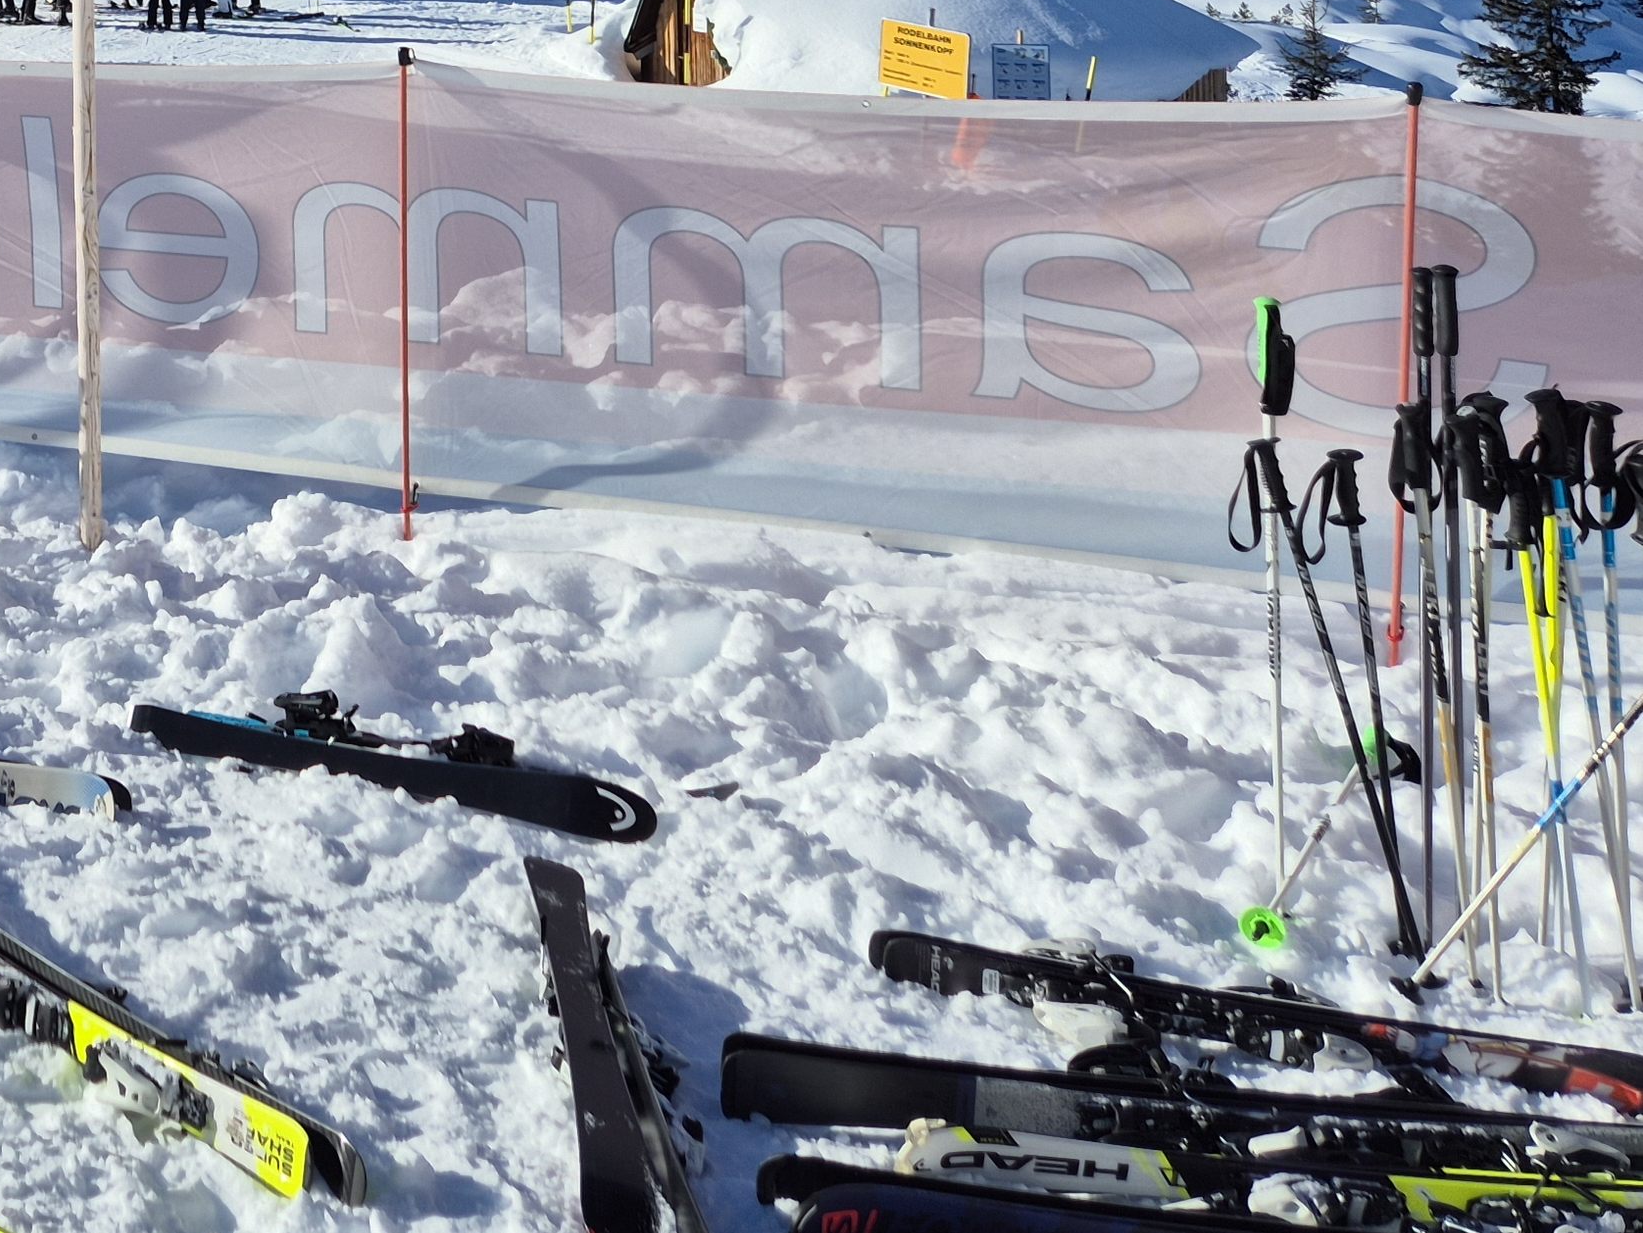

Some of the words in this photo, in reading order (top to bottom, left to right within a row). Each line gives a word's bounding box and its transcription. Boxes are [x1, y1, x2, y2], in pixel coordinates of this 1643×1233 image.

[893, 36, 955, 56] SONNENKOPF
[897, 26, 952, 44] RODELBAHN
[1423, 567, 1439, 620] LEKI
[1477, 640, 1489, 697] LEKI
[930, 944, 942, 996] HEAD
[940, 1150, 1130, 1182] HEAD
